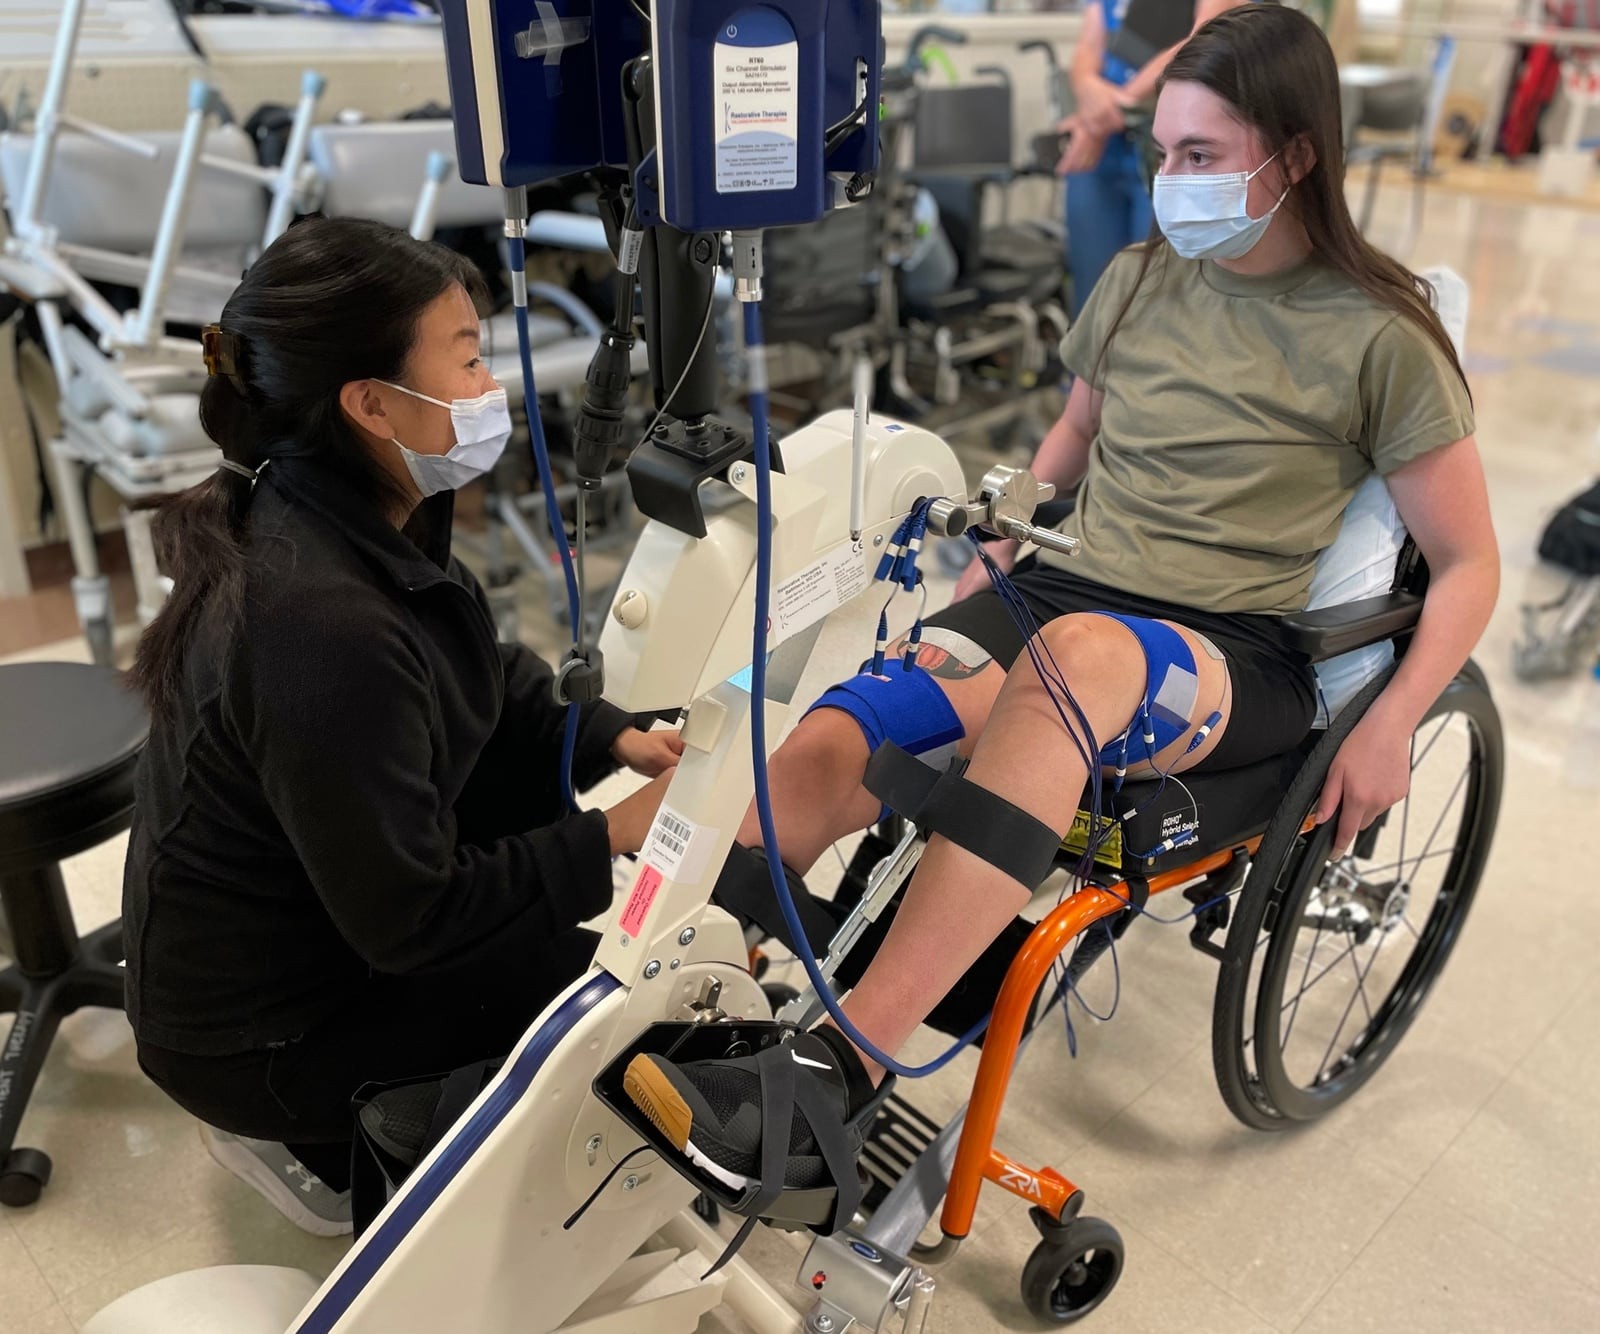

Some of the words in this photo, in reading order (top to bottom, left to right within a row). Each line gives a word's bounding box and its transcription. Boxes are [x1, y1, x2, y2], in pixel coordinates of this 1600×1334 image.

[762, 110, 787, 118] Therapies
[777, 577, 800, 593] Restorative
[1162, 824, 1181, 838] Hybrid
[648, 884, 658, 902] Battery
[622, 902, 635, 925] Required
[631, 901, 640, 916] Power
[637, 902, 651, 925] Operated
